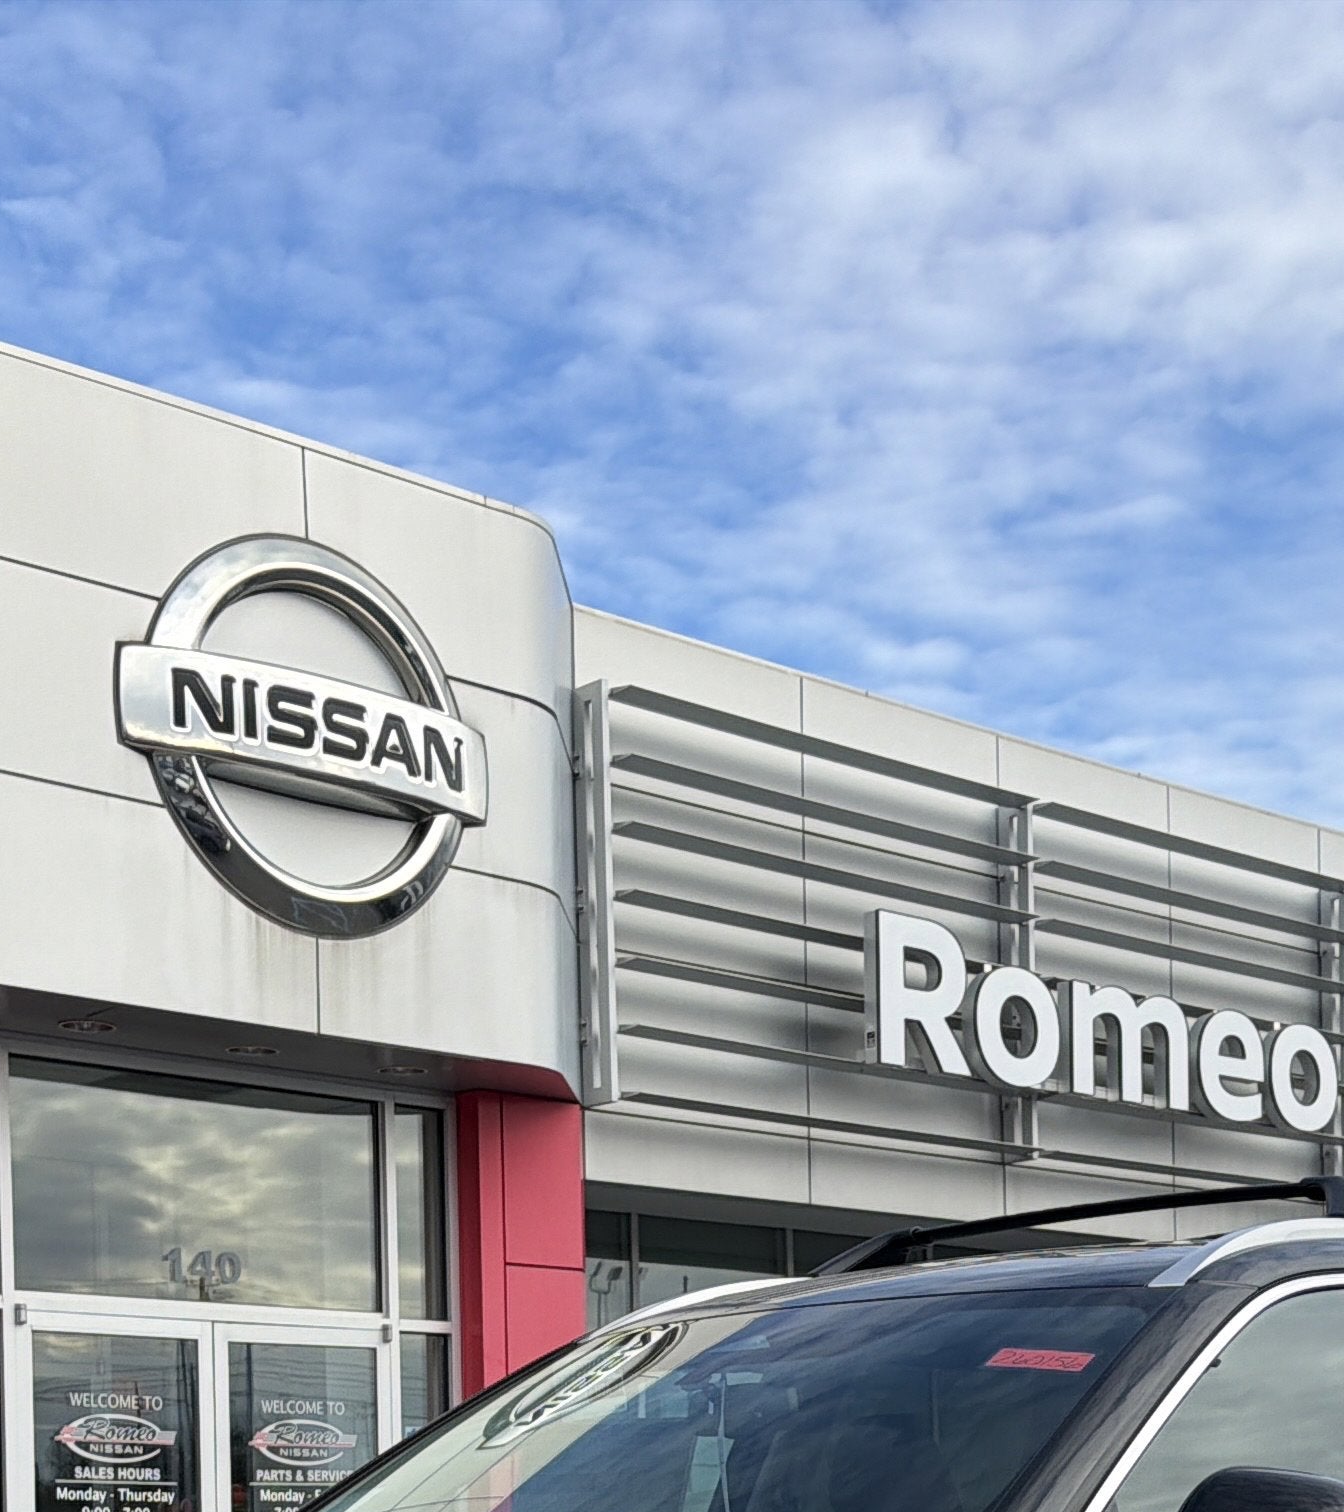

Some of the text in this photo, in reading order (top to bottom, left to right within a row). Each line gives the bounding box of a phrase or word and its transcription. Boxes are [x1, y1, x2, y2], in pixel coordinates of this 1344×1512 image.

[171, 667, 464, 794] NISSAN
[864, 908, 1339, 1133] Romeo
[162, 1246, 242, 1285] 140
[69, 1391, 163, 1411] WELCOME TO
[261, 1400, 345, 1415] WELCOME TO
[80, 1416, 157, 1441] Romeo
[272, 1422, 340, 1444] Romeo
[89, 1444, 144, 1454] NISSAN
[279, 1448, 328, 1457] NISSAN
[74, 1466, 161, 1480] SALES HOURS
[256, 1469, 293, 1481] PARTS
[295, 1470, 305, 1481] &
[56, 1487, 107, 1504] Monday
[117, 1488, 176, 1505] Thursday
[259, 1489, 305, 1504] Monday
